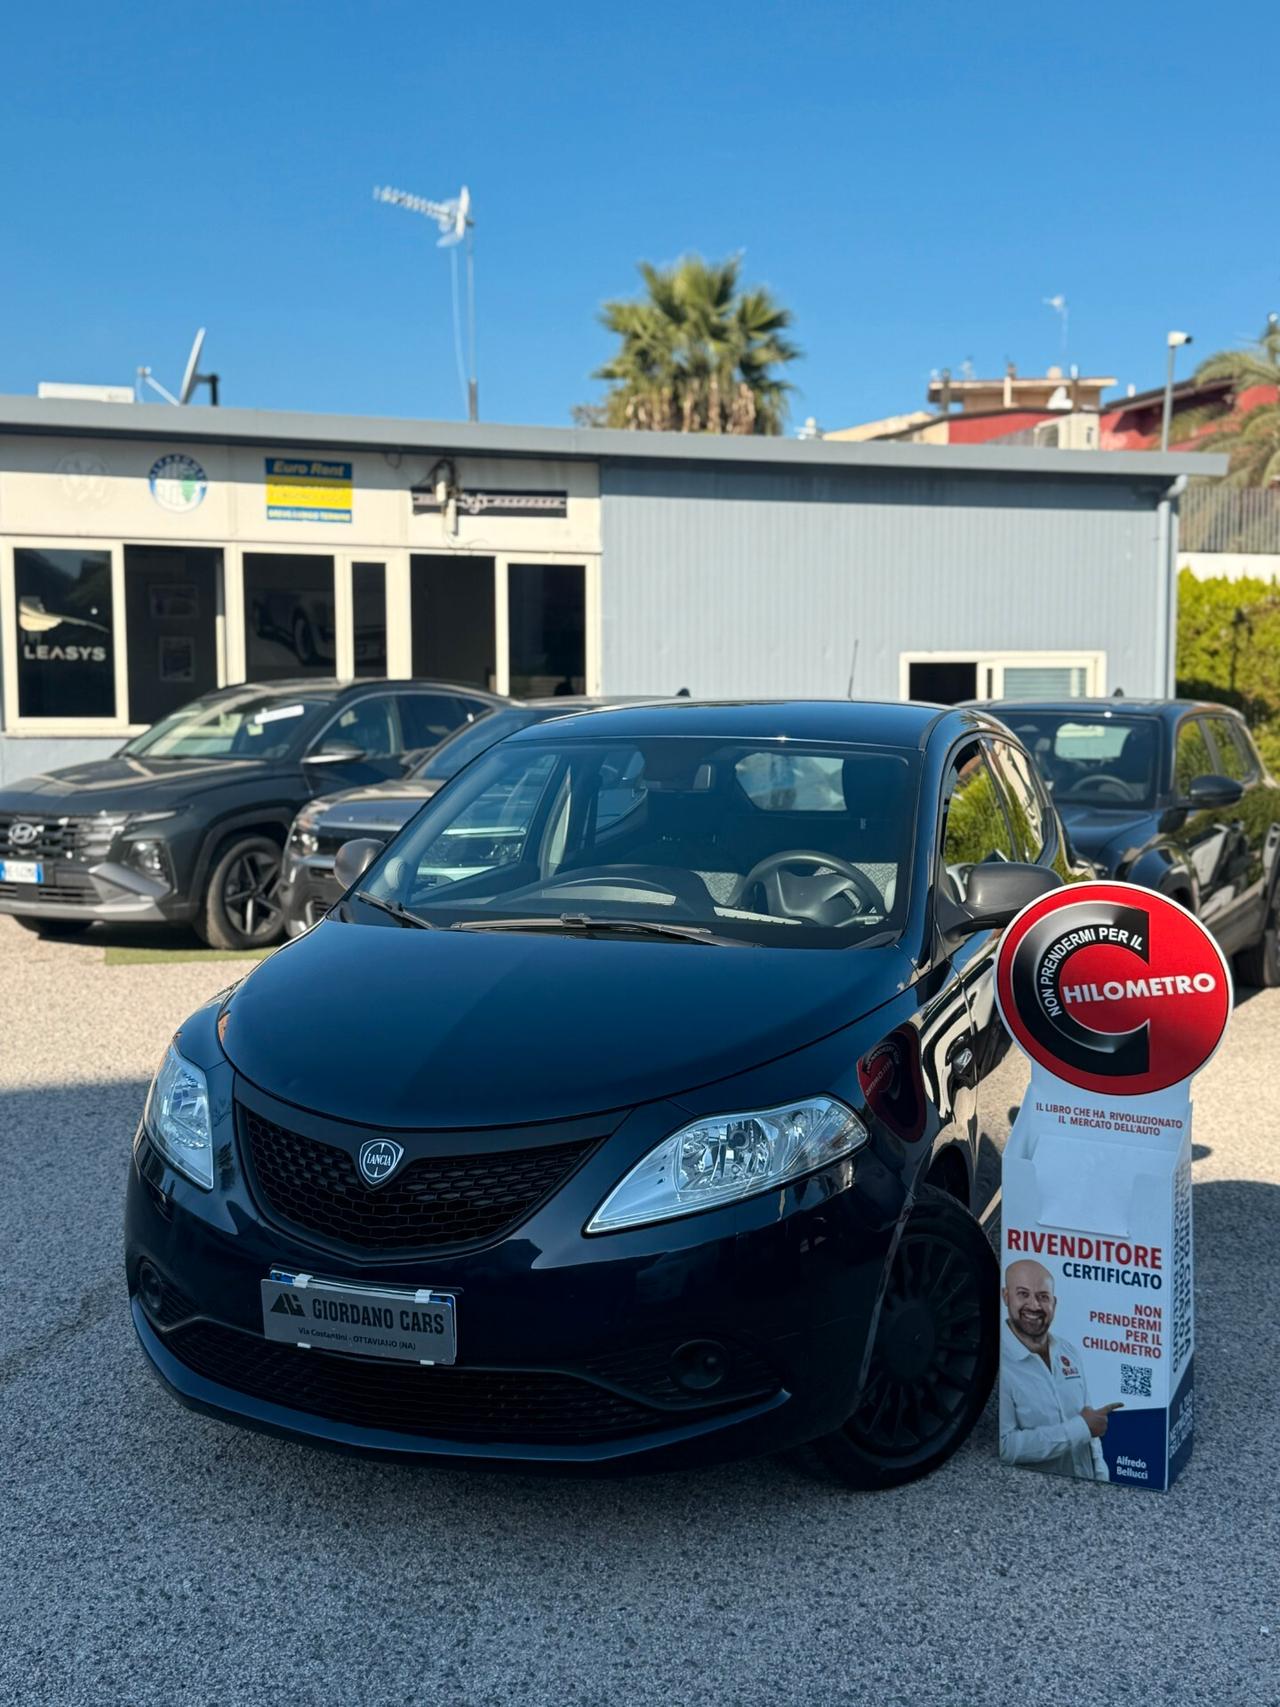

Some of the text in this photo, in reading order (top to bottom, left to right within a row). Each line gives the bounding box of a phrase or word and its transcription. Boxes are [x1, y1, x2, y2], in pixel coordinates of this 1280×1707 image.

[273, 460, 308, 474] Euro
[23, 645, 106, 661] LEASYS
[1040, 927, 1143, 1017] NON PRENDERMI PER IL
[1036, 1102, 1183, 1129] IL LIBRO CHE HA RIVOLUZIONATO
[1058, 1115, 1161, 1136] IL MERCATO DELL'AUTO
[367, 1153, 391, 1167] LANCIA
[1007, 1228, 1162, 1270] RIVENDITORE
[1062, 1262, 1162, 1290] CERTIFICATO
[312, 1298, 394, 1329] GIORDANO
[400, 1310, 444, 1335] CARS
[1089, 1311, 1162, 1332] PRENDERMI
[1134, 1304, 1162, 1319] NON
[298, 1327, 310, 1335] Via
[353, 1335, 398, 1348] OTTAVIANO
[1082, 1336, 1162, 1359] CHILOMETRO
[1125, 1329, 1162, 1346] PER IL
[1116, 1456, 1147, 1469] Alfredo
[1116, 1466, 1148, 1479] Bellucci
